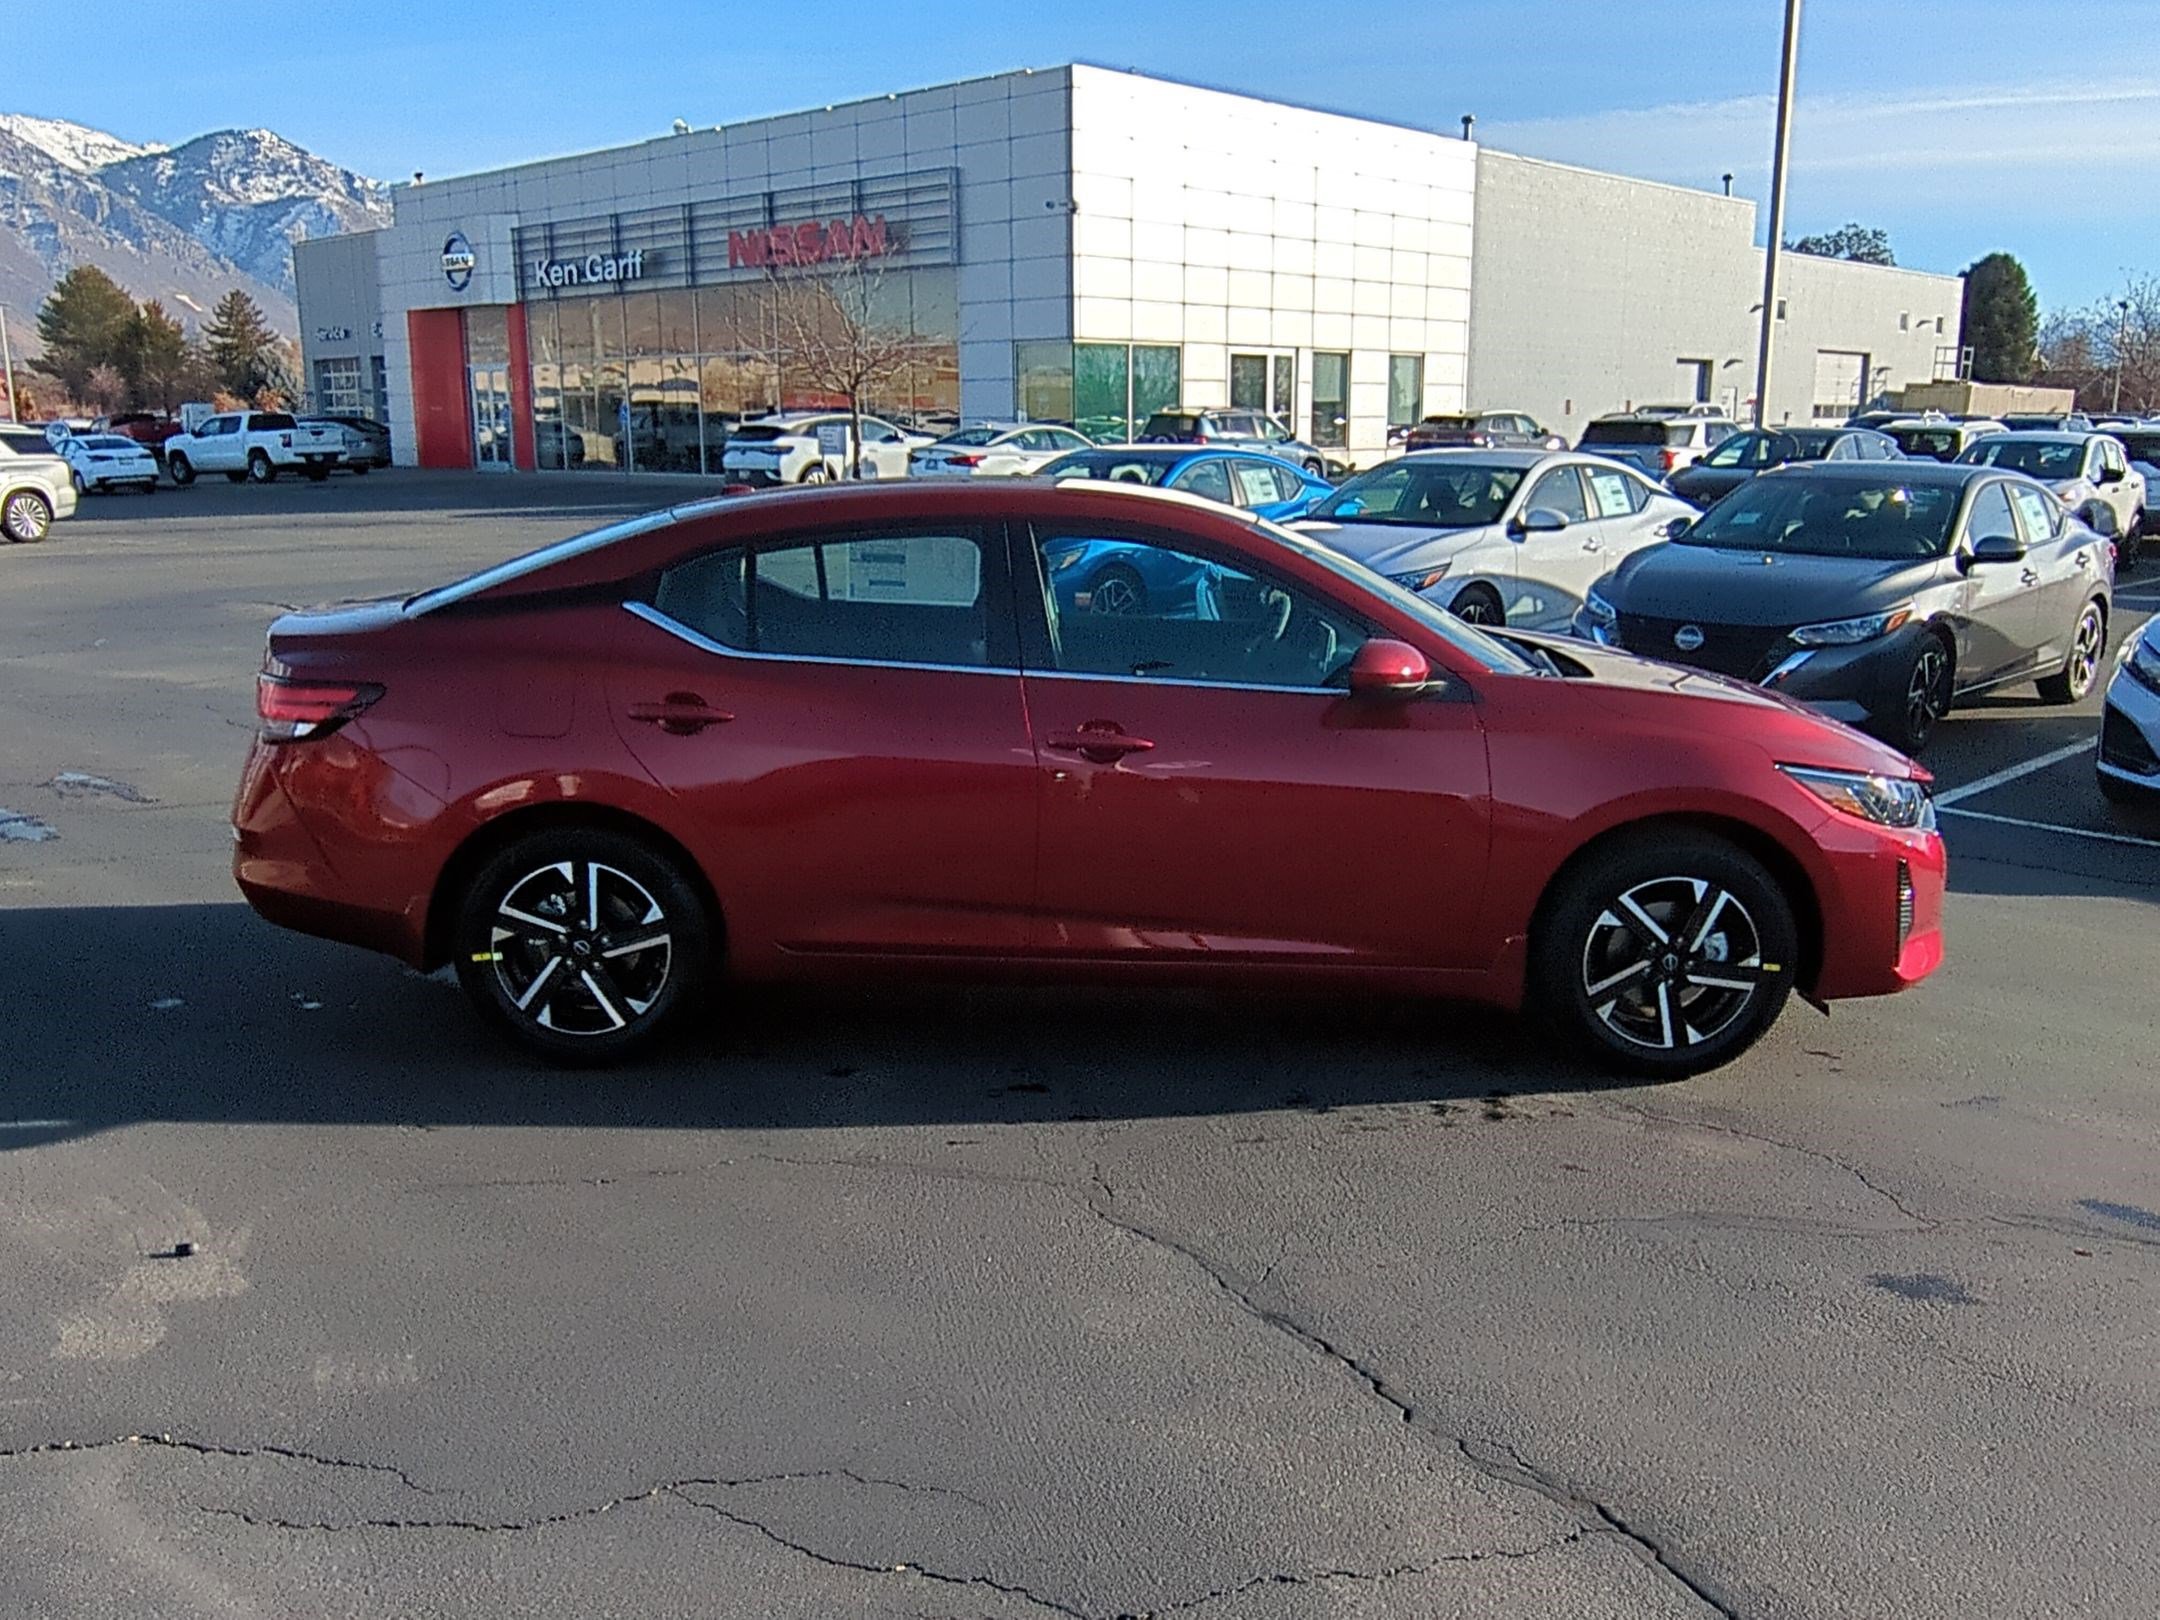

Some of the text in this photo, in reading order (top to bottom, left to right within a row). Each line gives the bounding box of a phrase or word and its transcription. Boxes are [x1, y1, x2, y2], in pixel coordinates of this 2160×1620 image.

[728, 213, 887, 269] NISSAN
[534, 249, 642, 287] Ken Garff
